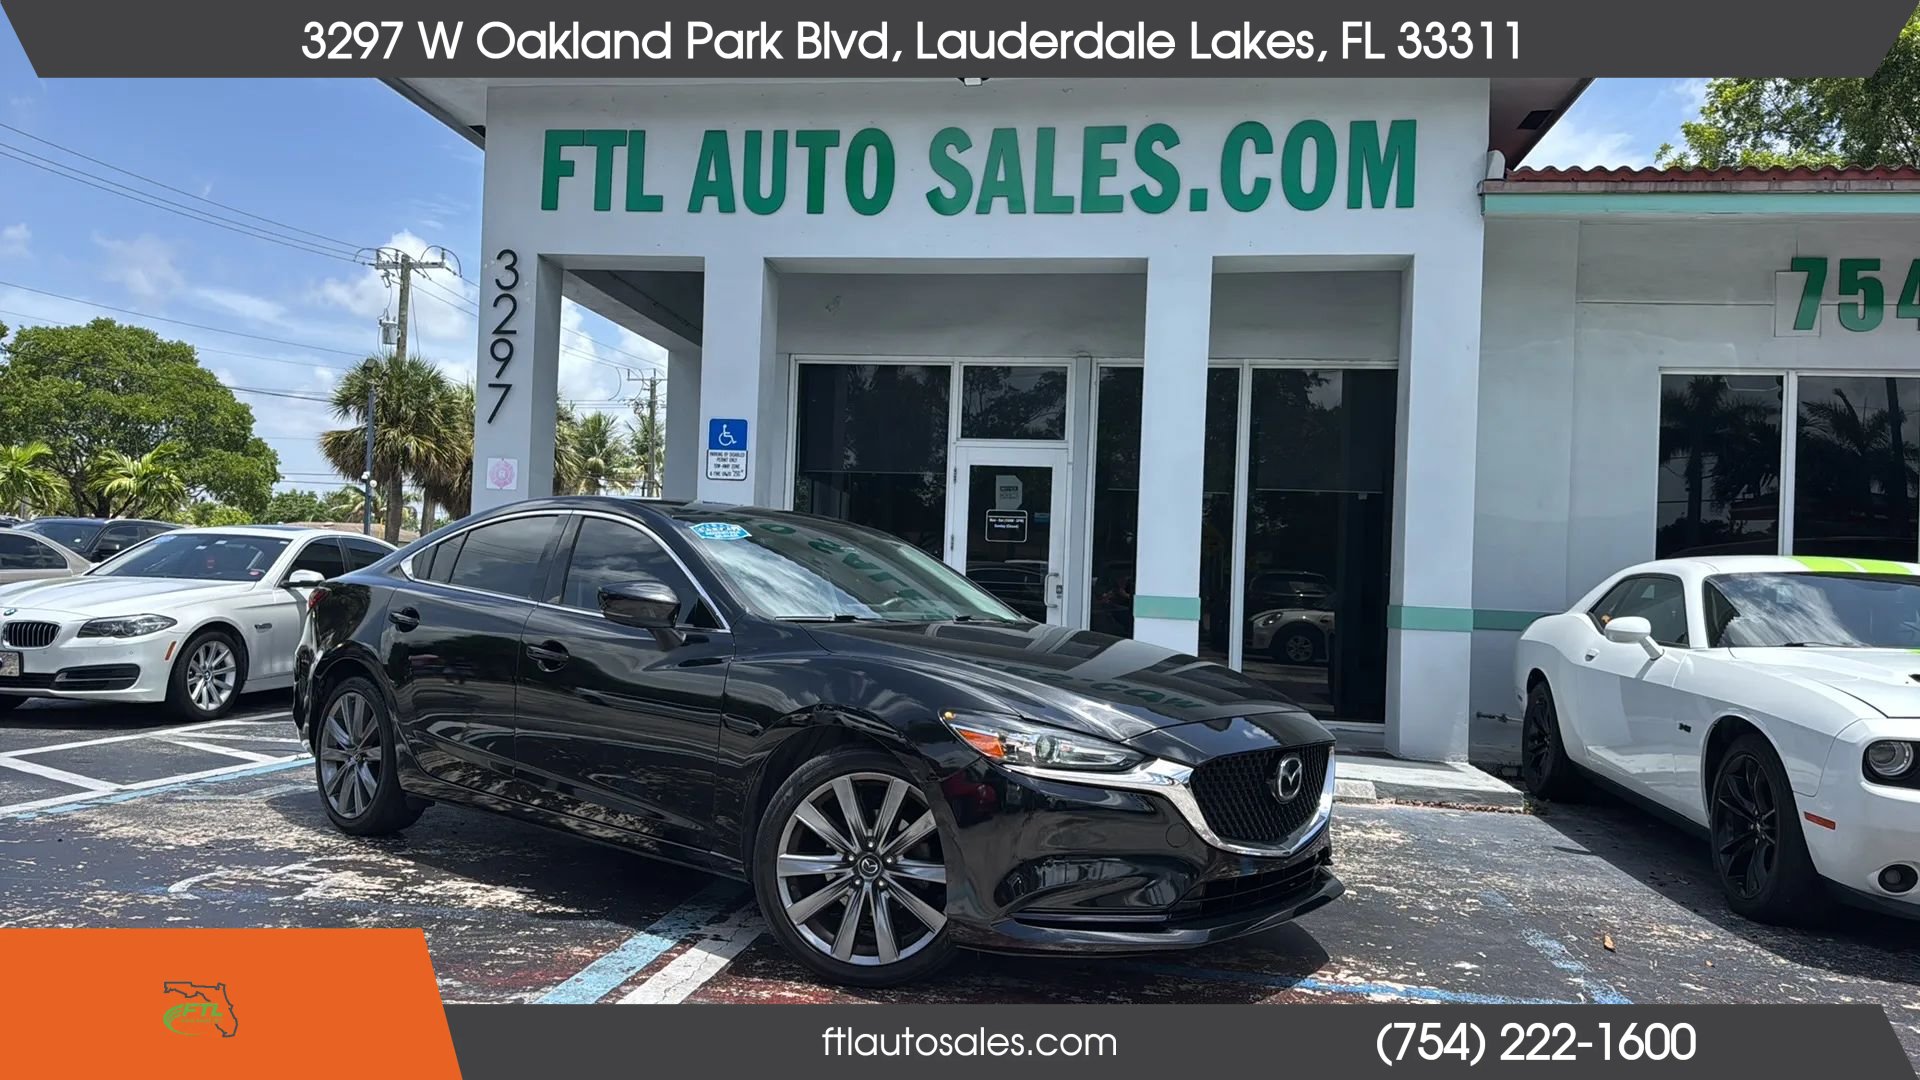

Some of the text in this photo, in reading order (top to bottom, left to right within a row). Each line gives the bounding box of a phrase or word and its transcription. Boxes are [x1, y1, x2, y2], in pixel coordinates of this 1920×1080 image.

[540, 118, 1418, 217] FTL AUTO SALES.COM
[487, 249, 519, 424] 3297
